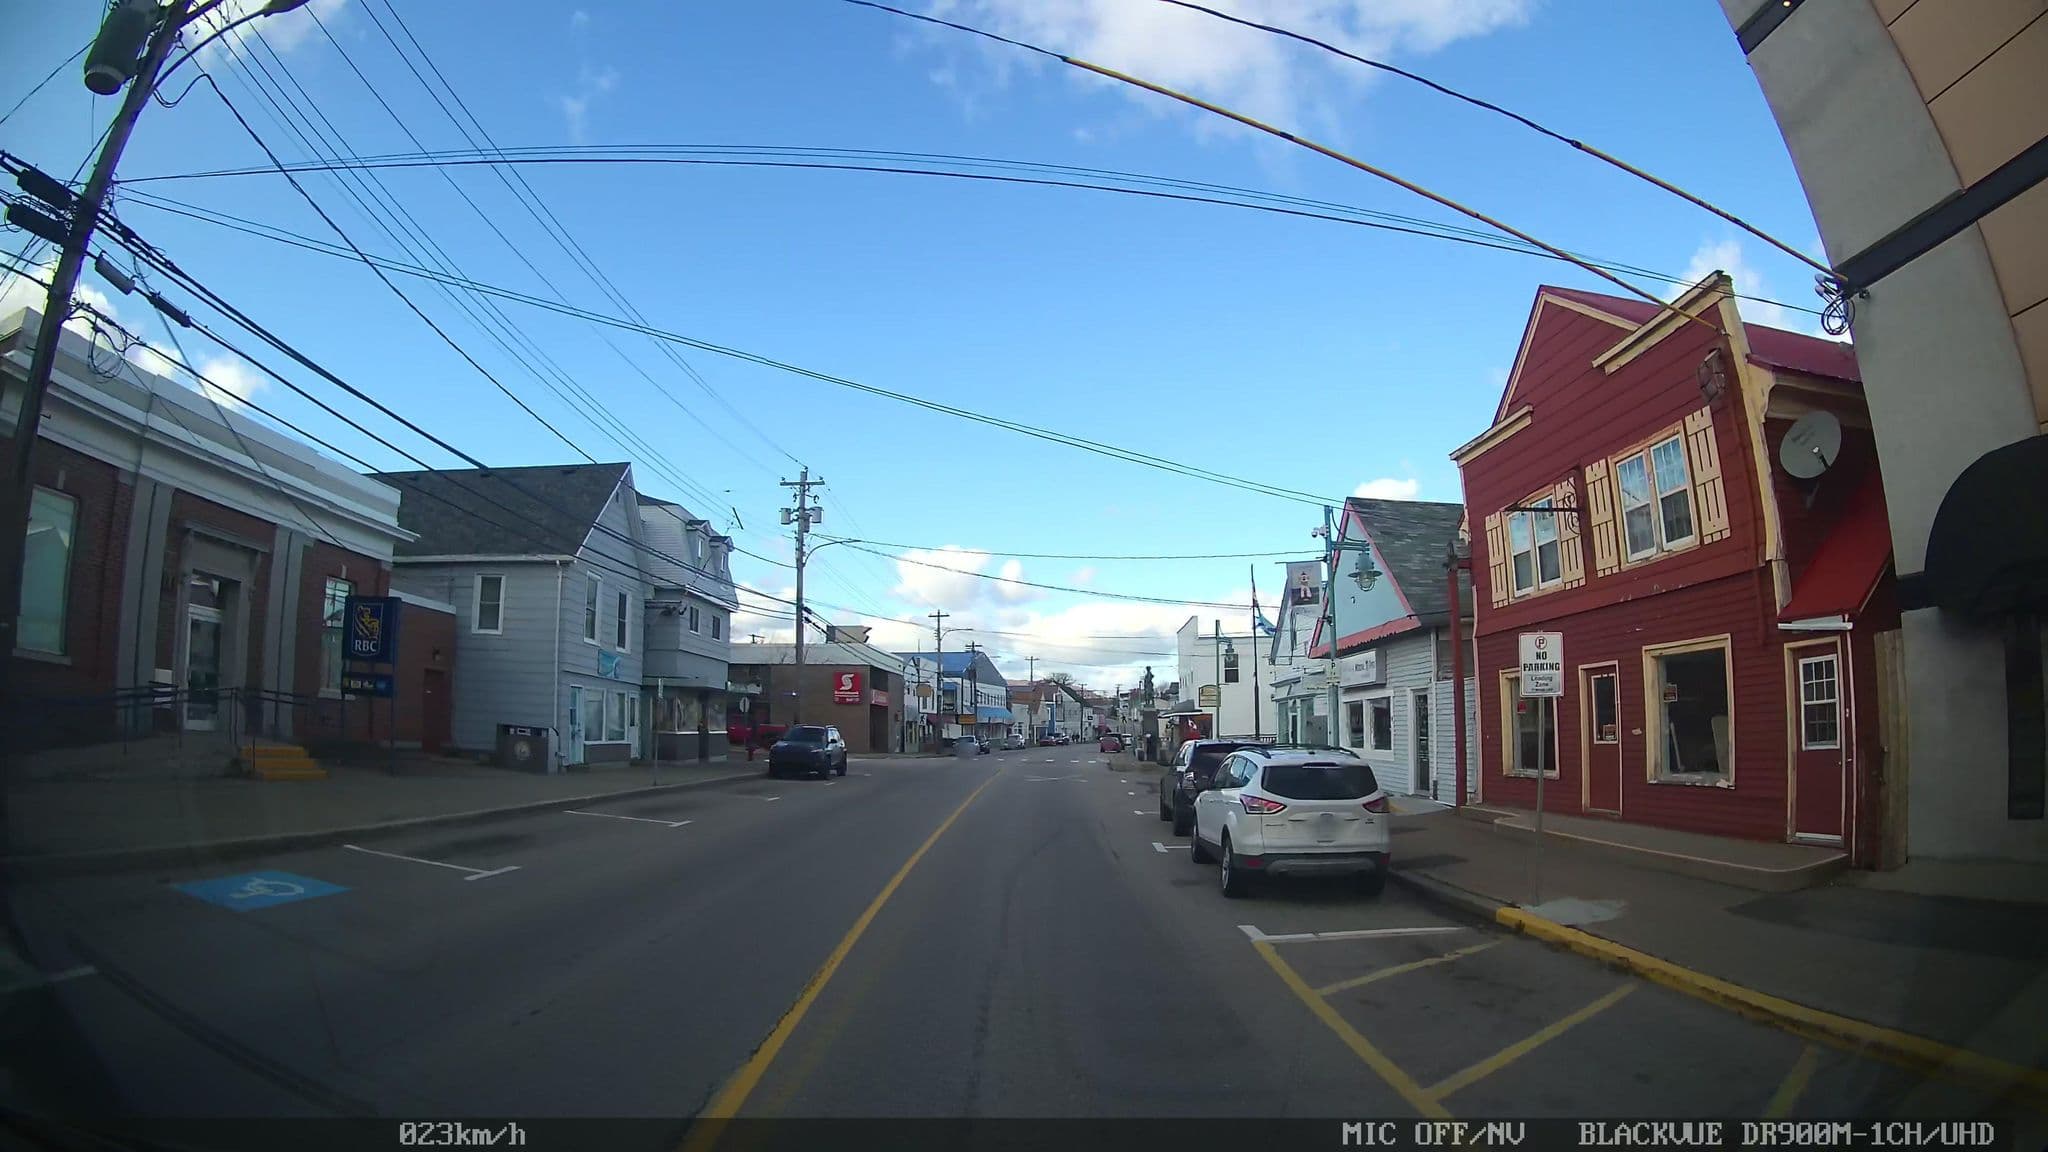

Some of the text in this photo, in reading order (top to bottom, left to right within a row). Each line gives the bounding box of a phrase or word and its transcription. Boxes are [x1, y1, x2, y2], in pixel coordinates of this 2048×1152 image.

[354, 639, 377, 652] RBC
[1535, 651, 1548, 660] NO
[1523, 662, 1561, 672] PARKING
